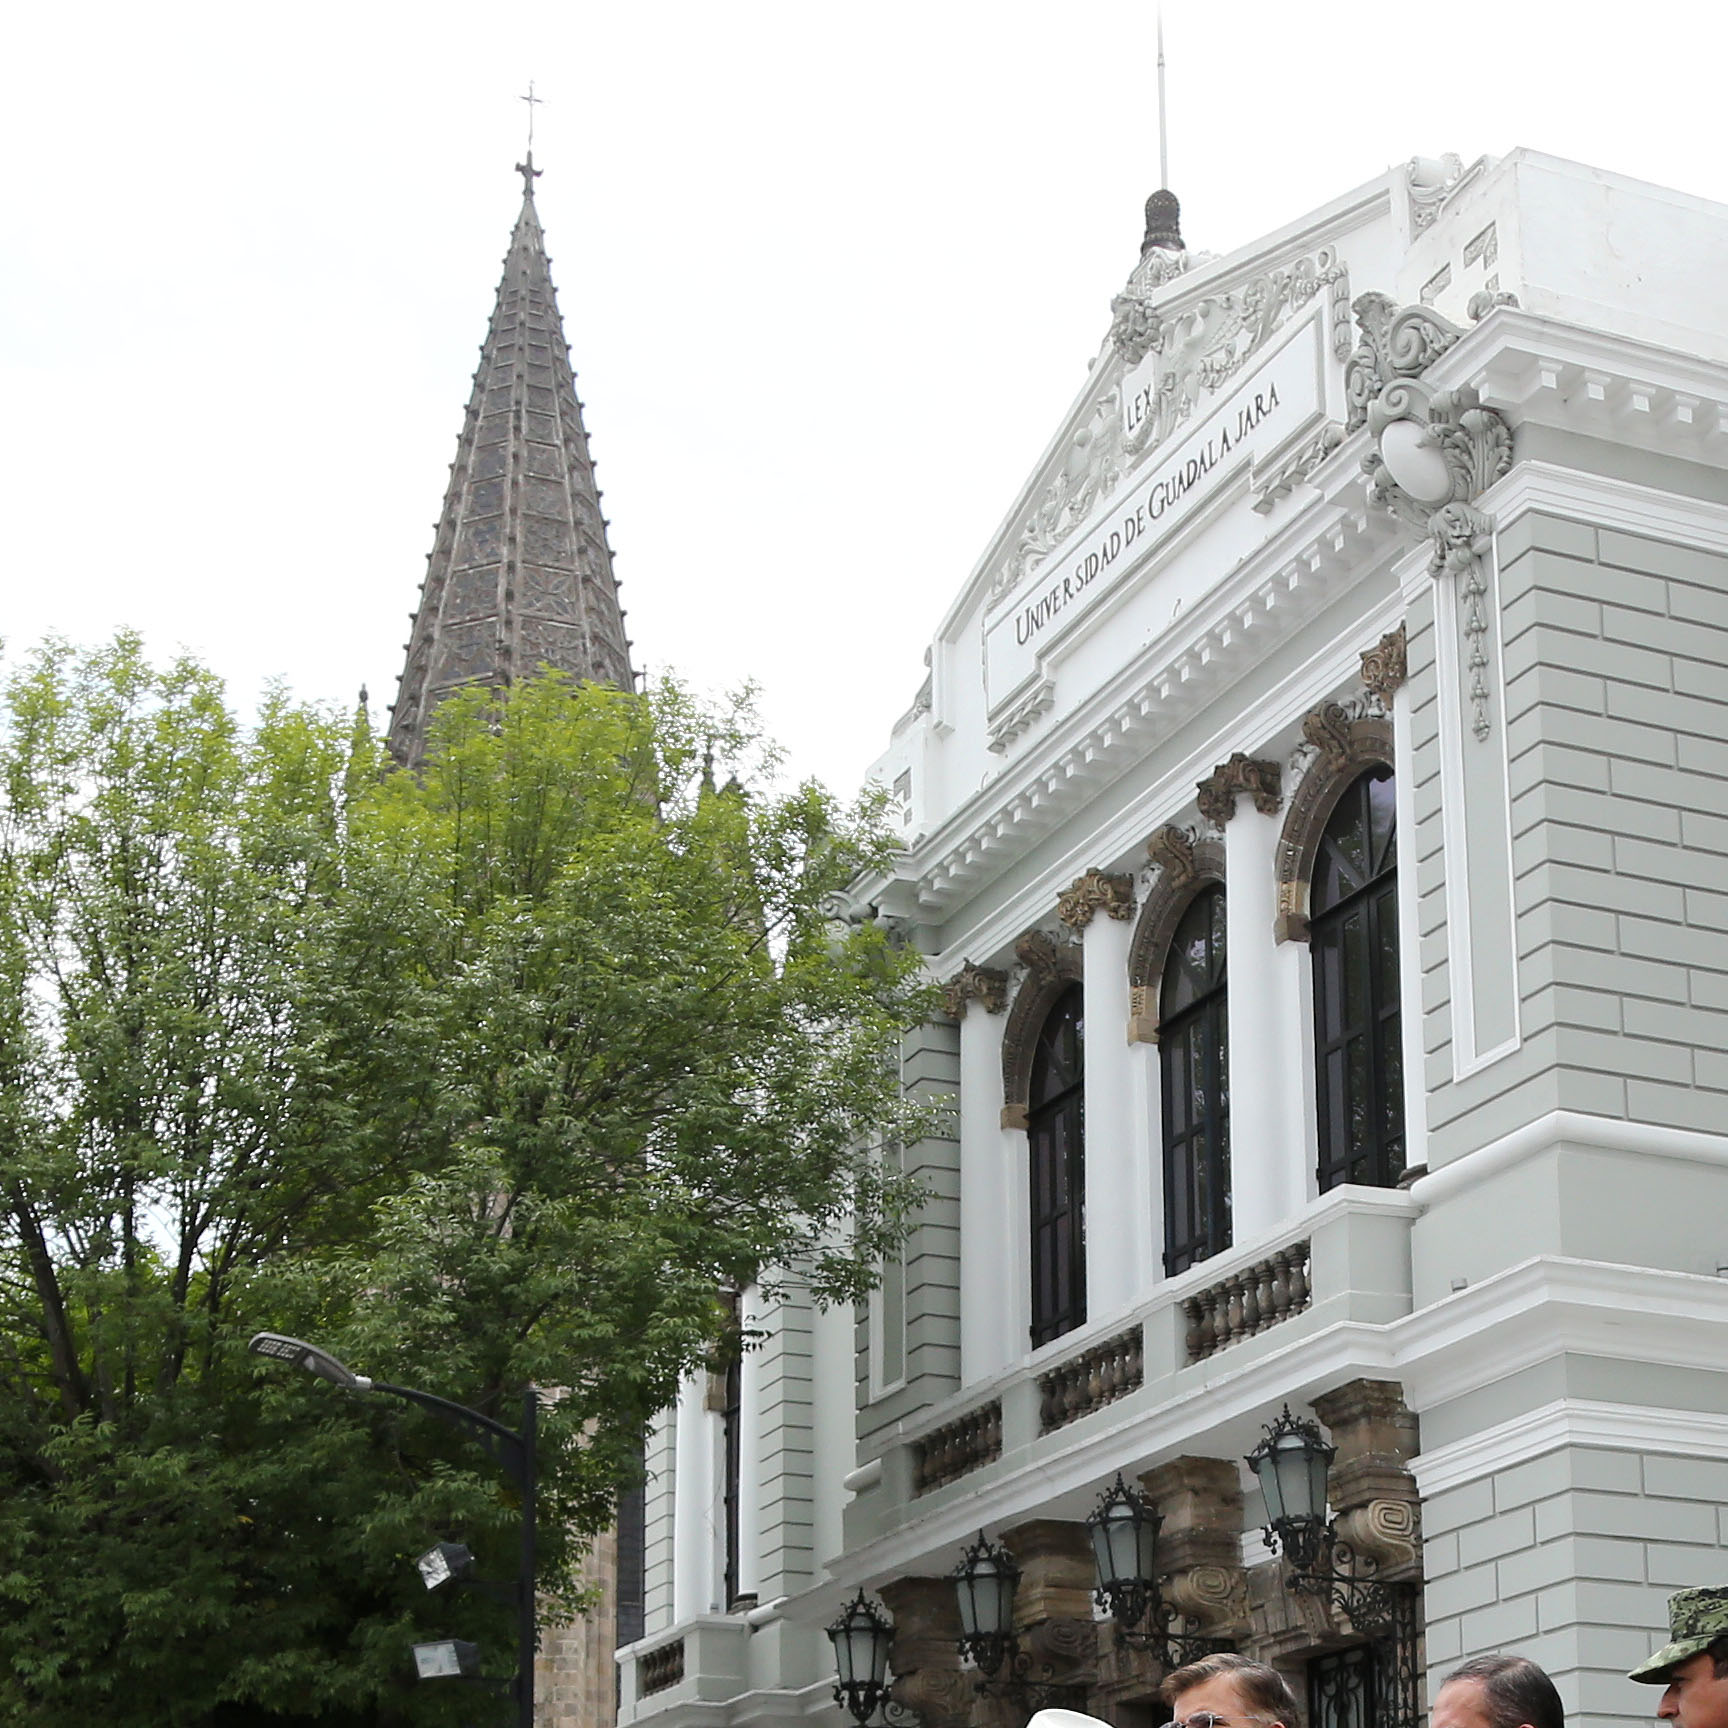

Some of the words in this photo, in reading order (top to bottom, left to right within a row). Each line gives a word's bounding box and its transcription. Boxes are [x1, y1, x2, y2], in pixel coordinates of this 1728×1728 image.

[1127, 383, 1153, 432] LEX
[1015, 531, 1121, 646] UNIVERSIDAD
[1124, 504, 1146, 548] DE
[1148, 384, 1281, 520] GUADALAJARA
